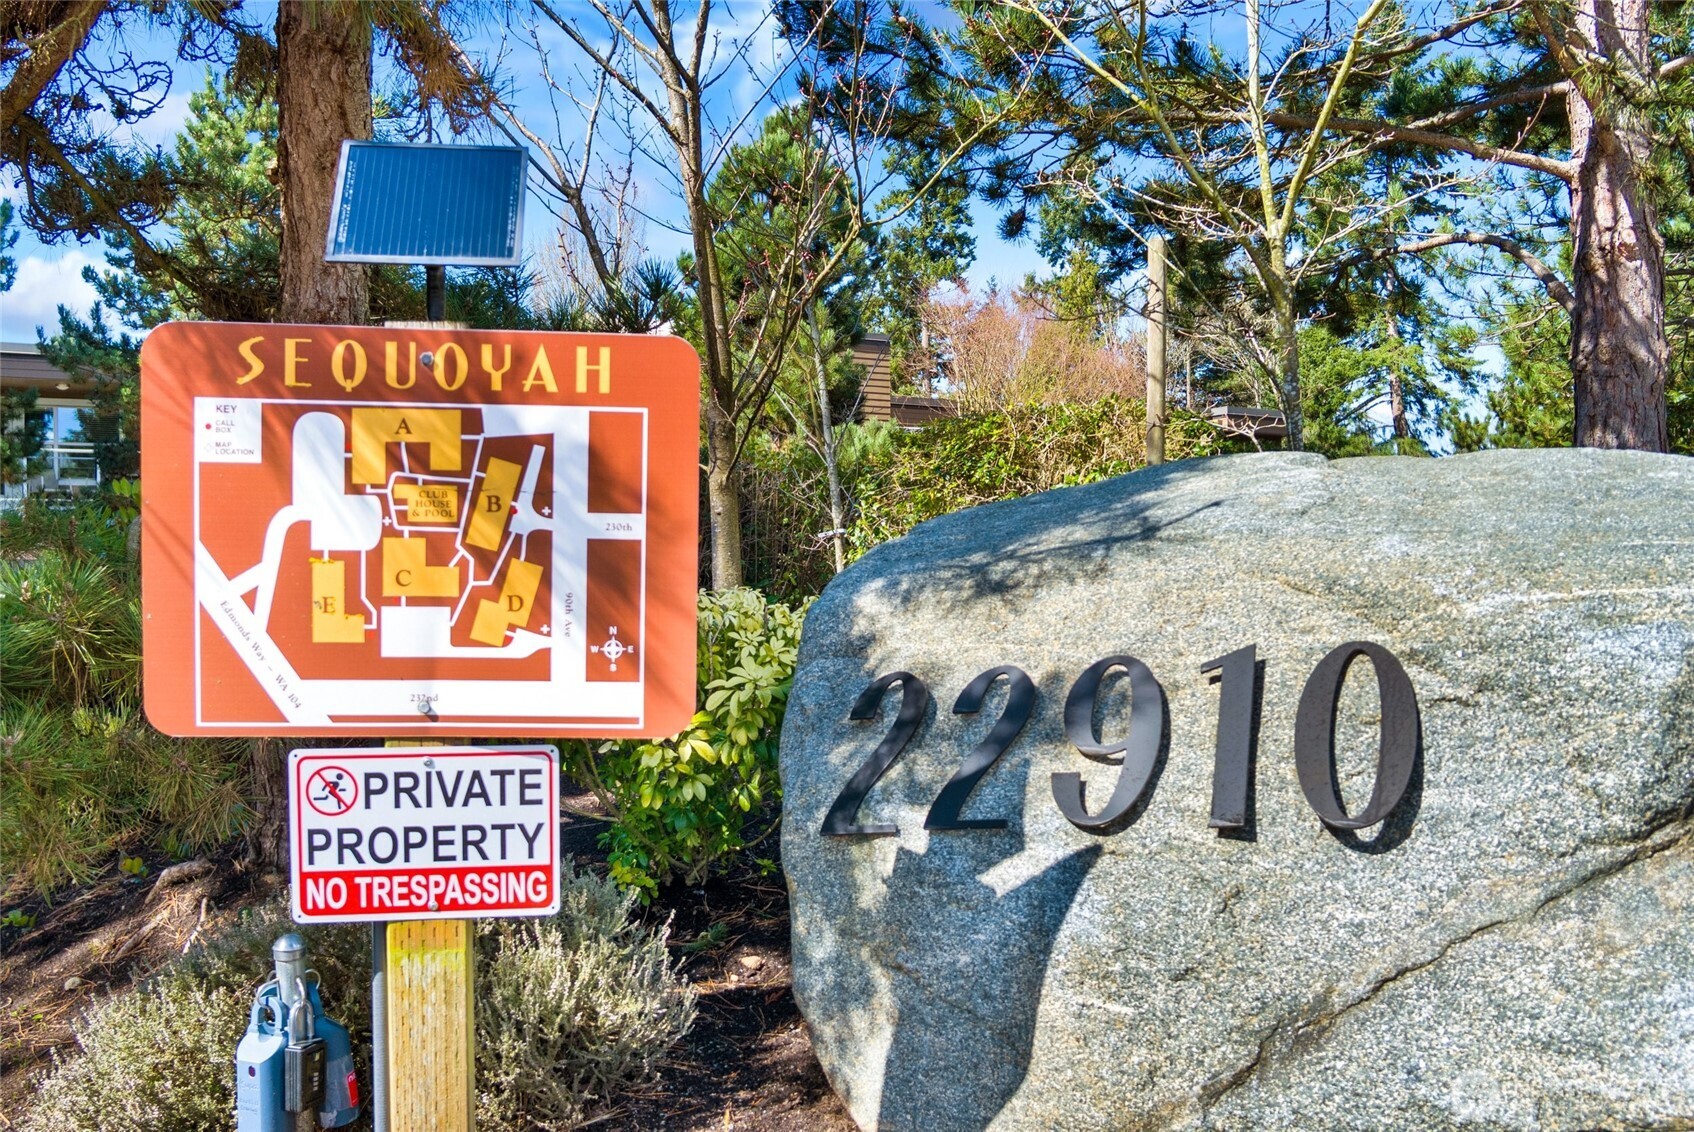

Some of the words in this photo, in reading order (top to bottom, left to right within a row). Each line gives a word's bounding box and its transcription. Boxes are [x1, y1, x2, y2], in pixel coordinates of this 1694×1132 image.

[236, 336, 611, 394] SEQUOYAH
[216, 405, 237, 413] KEY
[394, 417, 412, 435] A
[419, 490, 448, 499] CLUB
[415, 500, 452, 508] HOUSE
[486, 495, 502, 513] B
[425, 509, 454, 518] POOL
[605, 522, 632, 532] 230th
[395, 569, 412, 587] C
[322, 596, 336, 614] E
[507, 594, 524, 612] D
[564, 592, 574, 615] 90th
[564, 619, 573, 637] Ave
[220, 600, 251, 641] Edmonds
[251, 642, 266, 661] Way
[275, 674, 288, 692] WA
[288, 693, 302, 709] 104
[609, 663, 617, 671] S
[410, 694, 439, 702] 232nd
[820, 641, 1419, 836] 22910
[364, 769, 543, 809] PRIVATE
[307, 823, 545, 865] PROPERTY
[306, 877, 347, 910] NO
[354, 870, 548, 909] TRESPASSING
